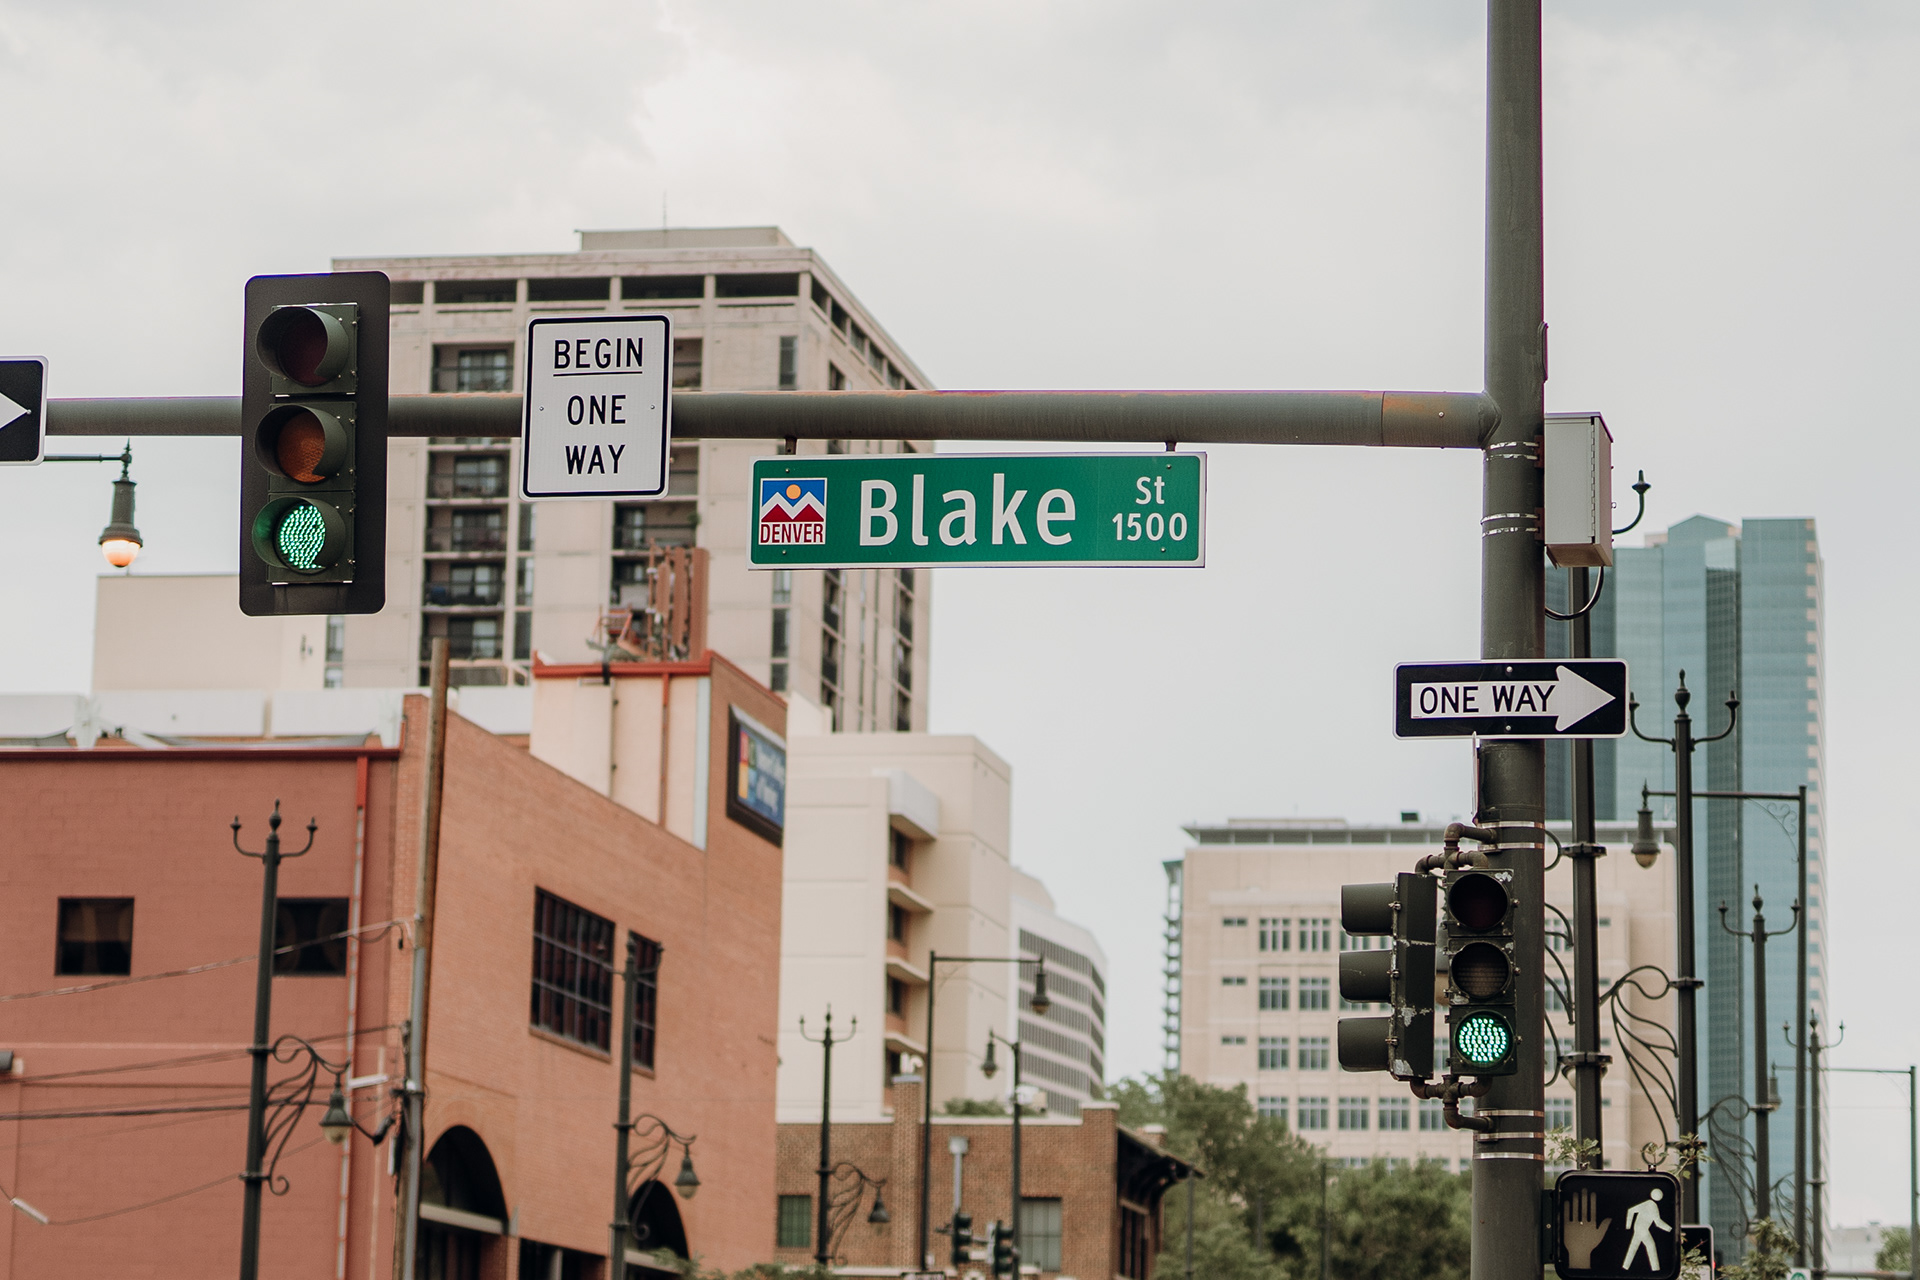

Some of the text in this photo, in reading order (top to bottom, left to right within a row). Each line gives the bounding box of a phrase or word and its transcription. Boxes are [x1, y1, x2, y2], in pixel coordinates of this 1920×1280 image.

[554, 337, 643, 369] BEGIN
[567, 394, 626, 425] ONE
[565, 444, 626, 474] WAY
[859, 473, 1165, 546] Blake St
[760, 523, 824, 543] DENVER
[1112, 512, 1188, 541] 1500
[1419, 684, 1556, 714] ONE WAY
